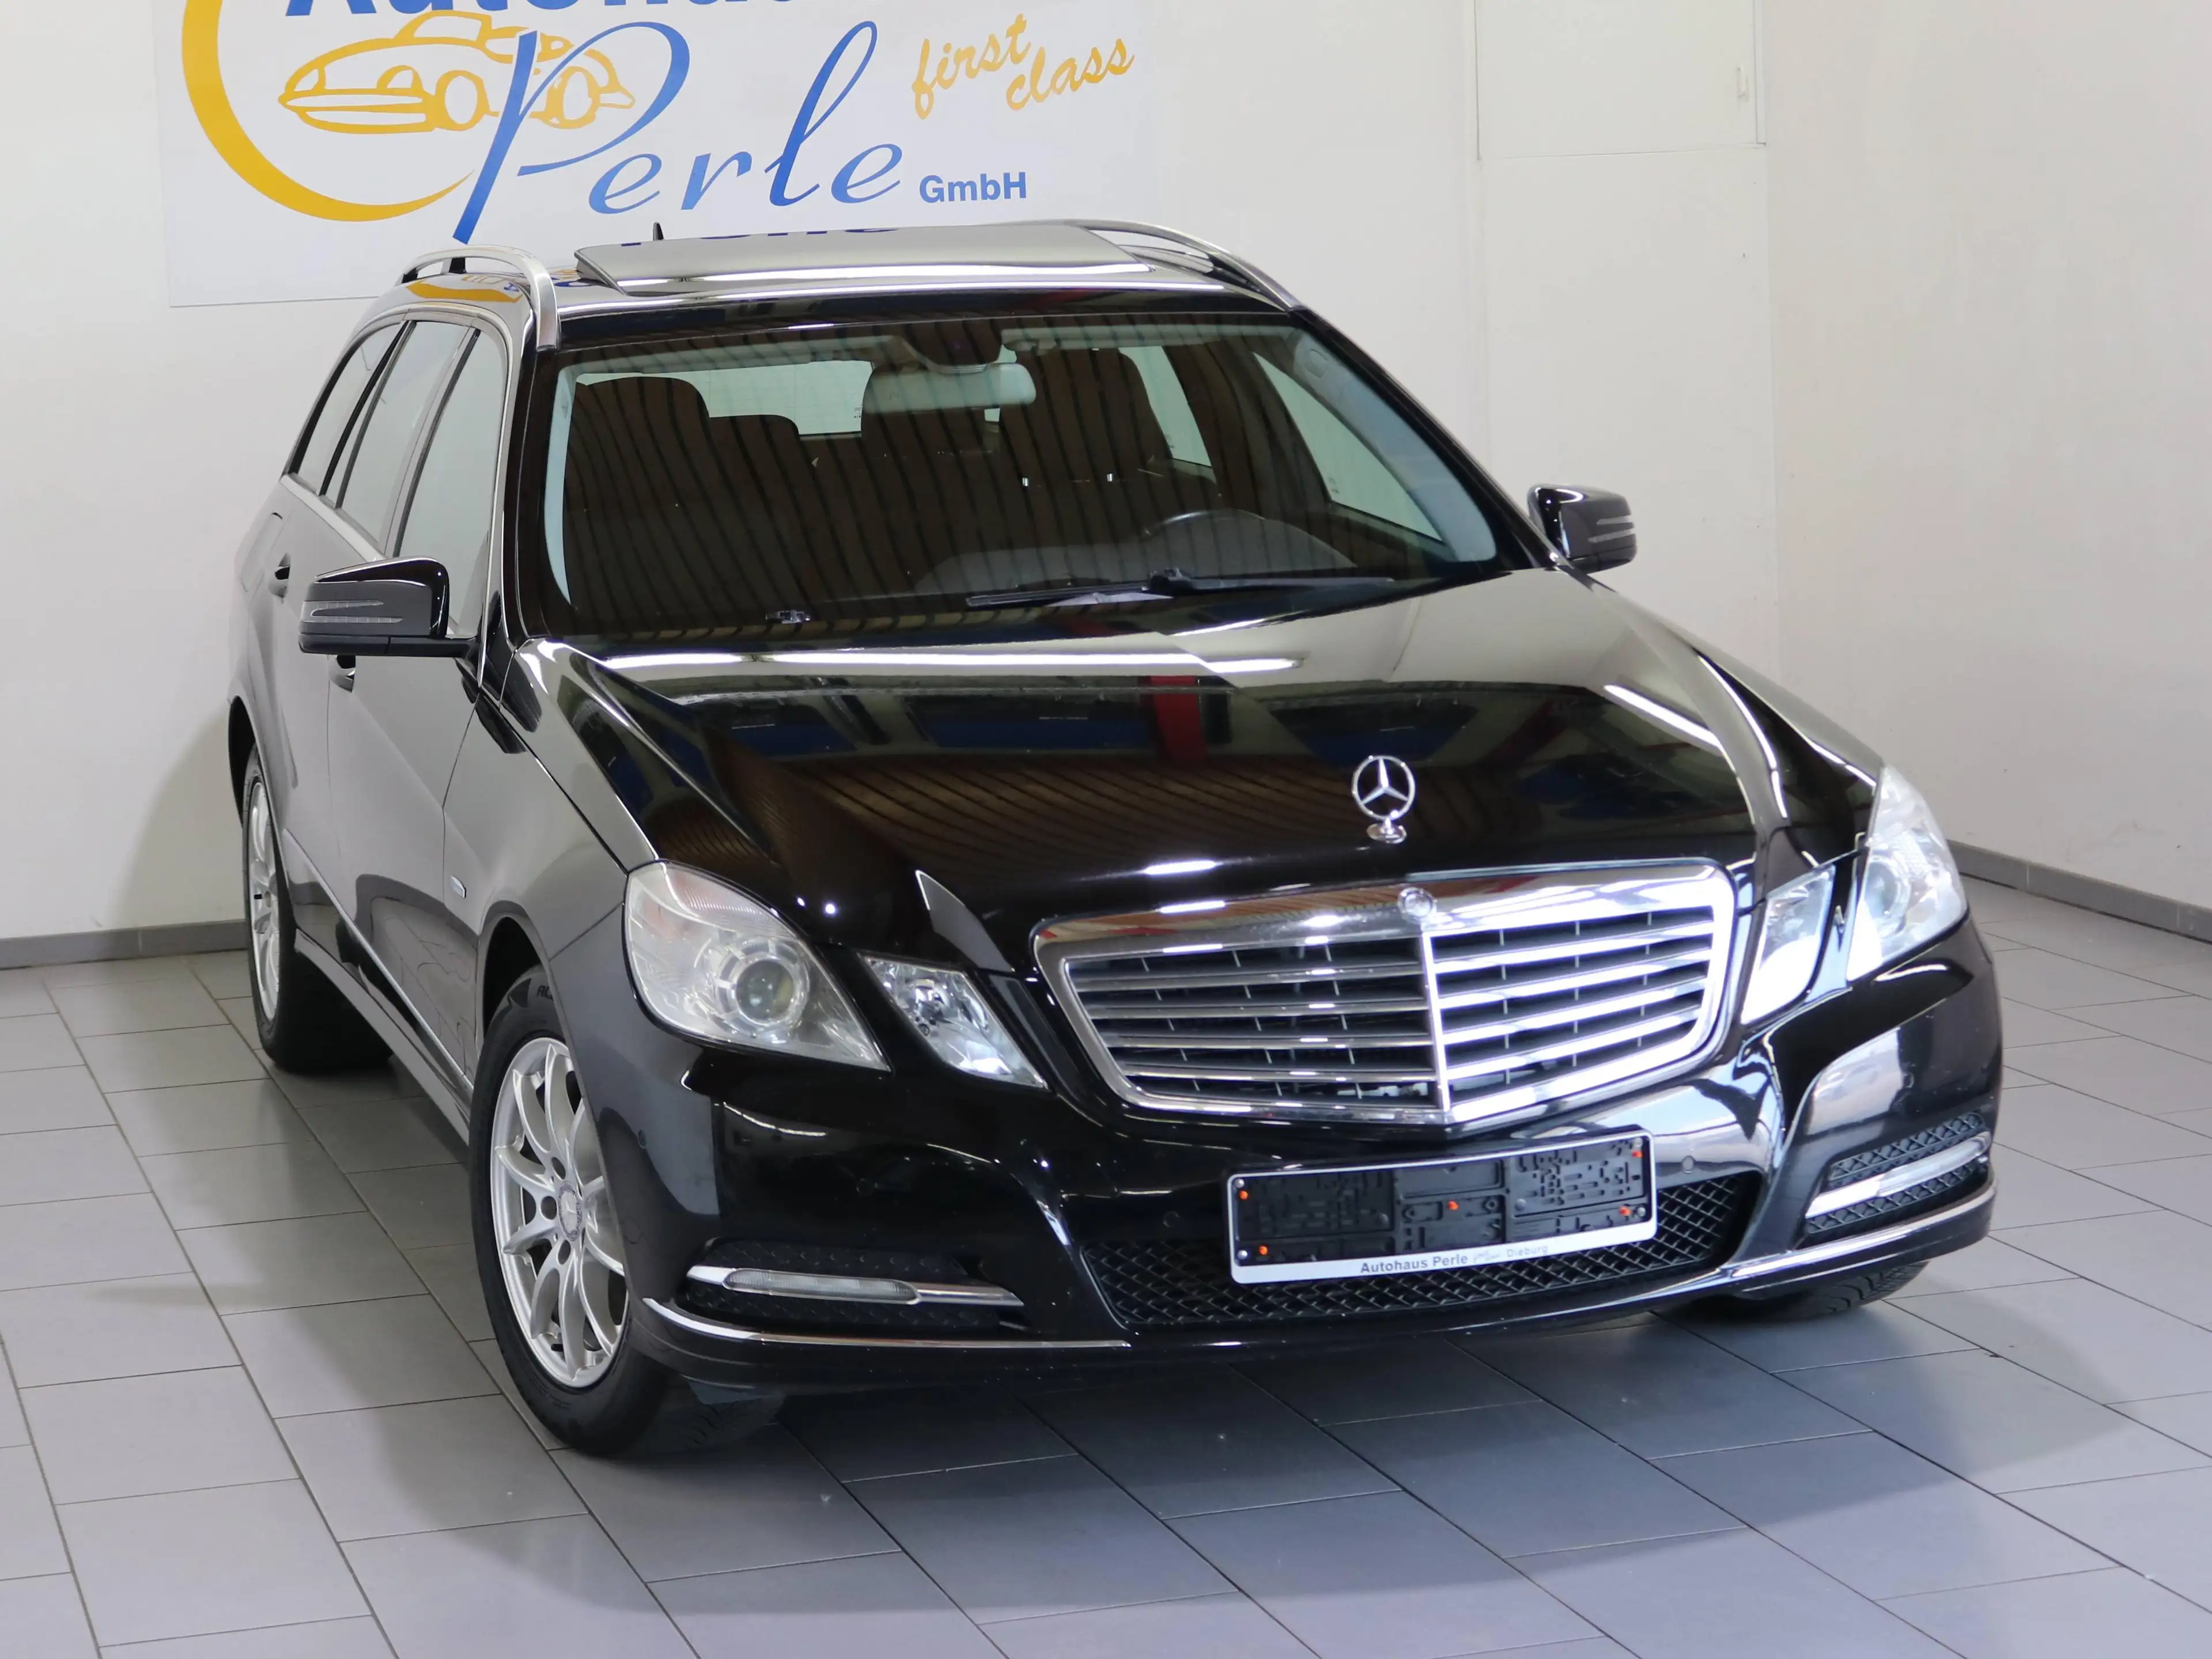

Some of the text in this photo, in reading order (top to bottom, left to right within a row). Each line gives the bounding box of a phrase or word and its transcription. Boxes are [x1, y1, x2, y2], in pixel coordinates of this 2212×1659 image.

[912, 14, 1031, 119] first
[1006, 38, 1135, 111] class
[452, 21, 1027, 245] Perle GmbH
[1360, 1258, 1428, 1274] Autohaus
[1433, 1254, 1468, 1267] Perle
